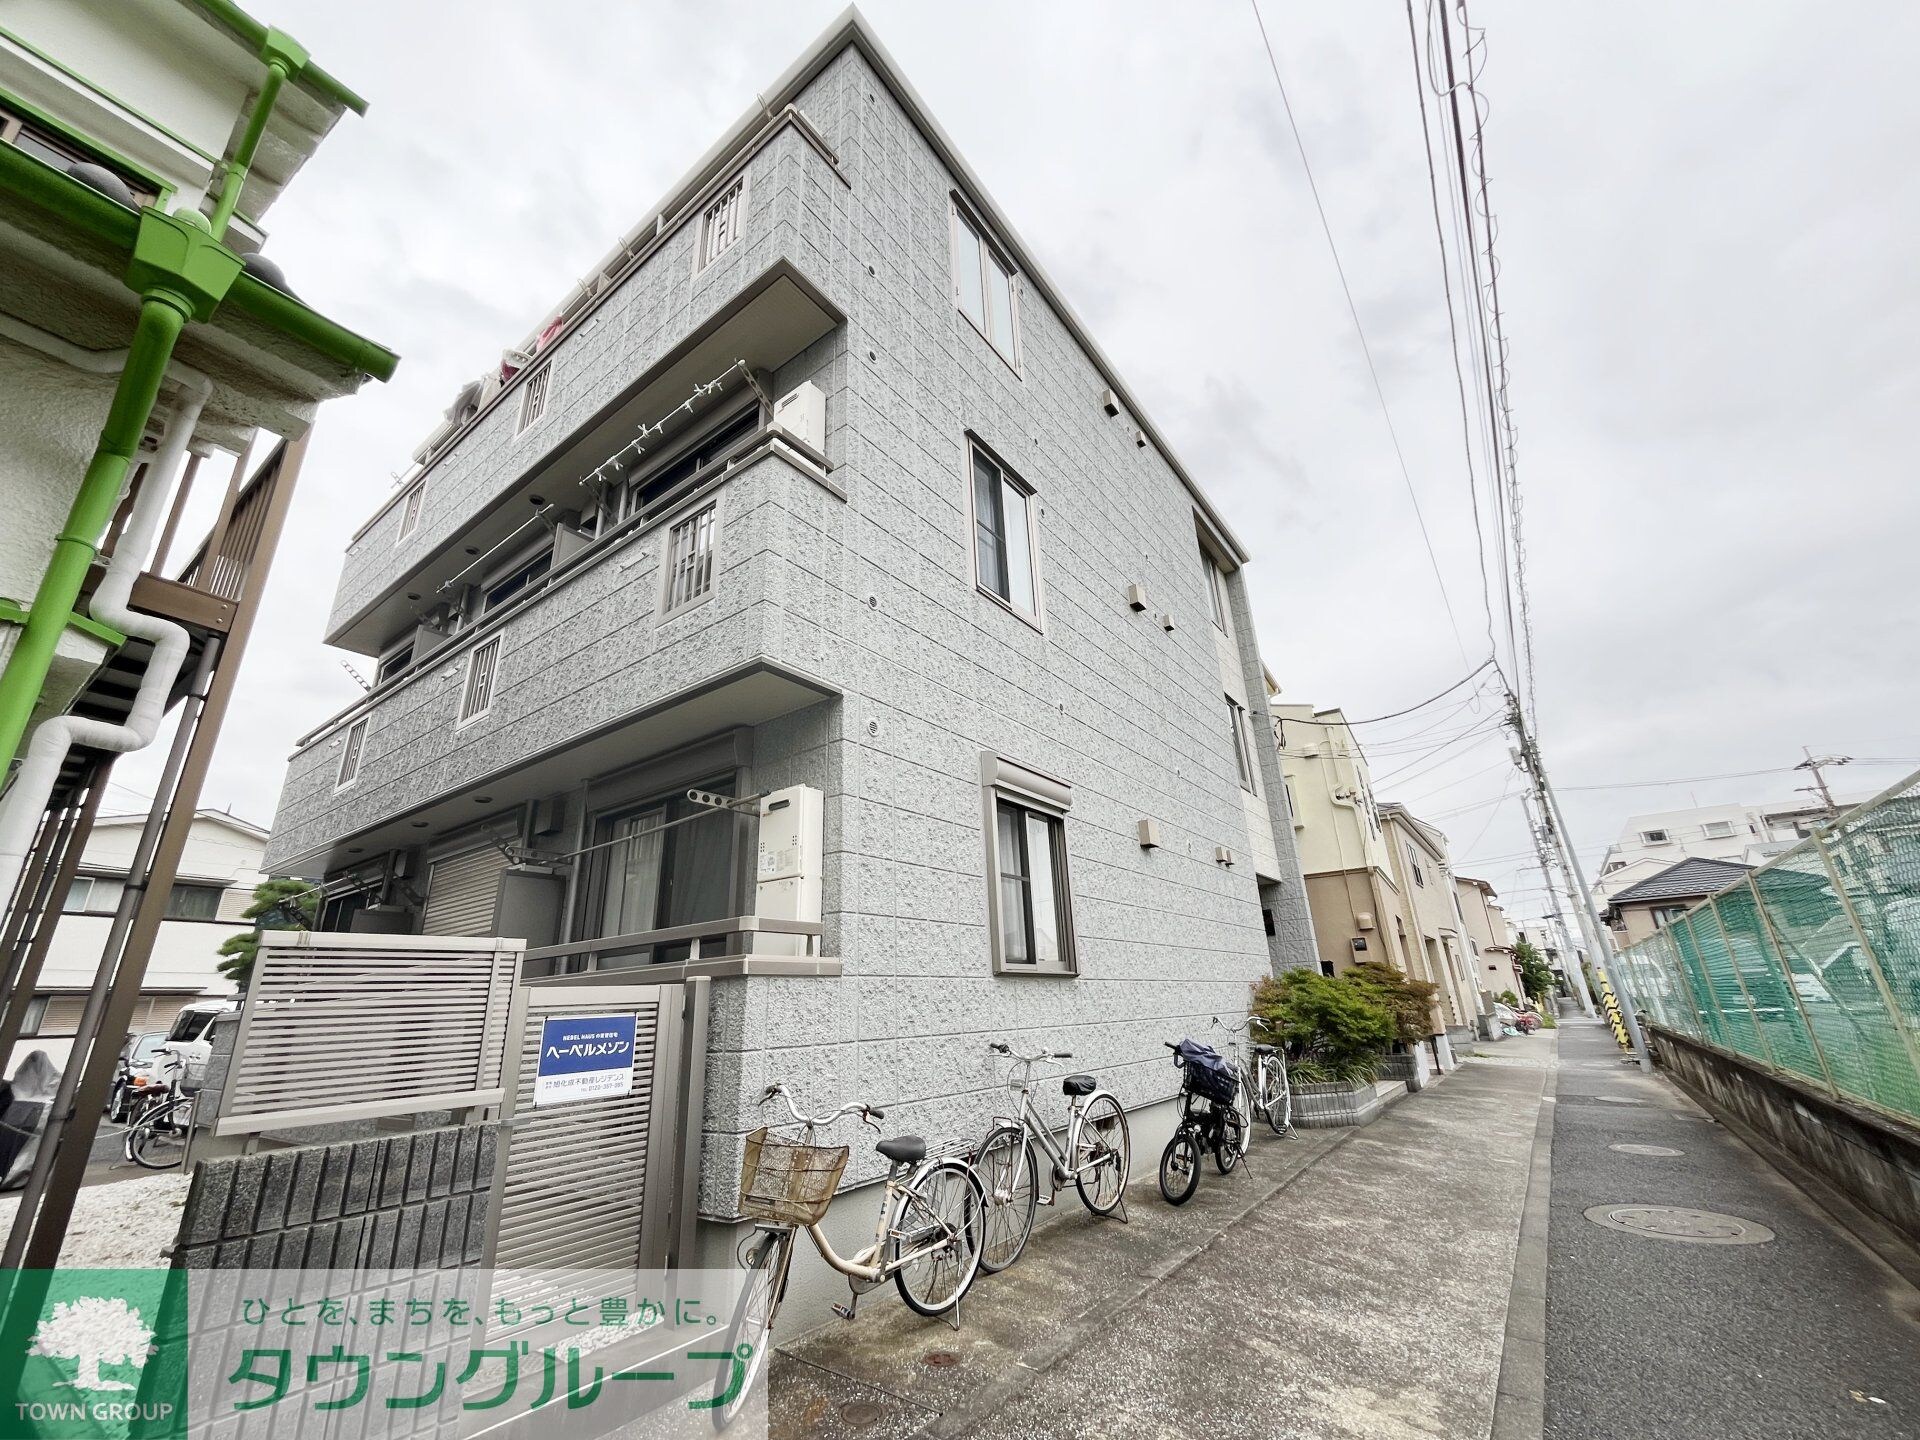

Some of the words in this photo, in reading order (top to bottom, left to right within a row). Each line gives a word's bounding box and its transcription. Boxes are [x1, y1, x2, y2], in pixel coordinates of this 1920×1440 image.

[546, 1041, 630, 1059] ヘーベルメゾン
